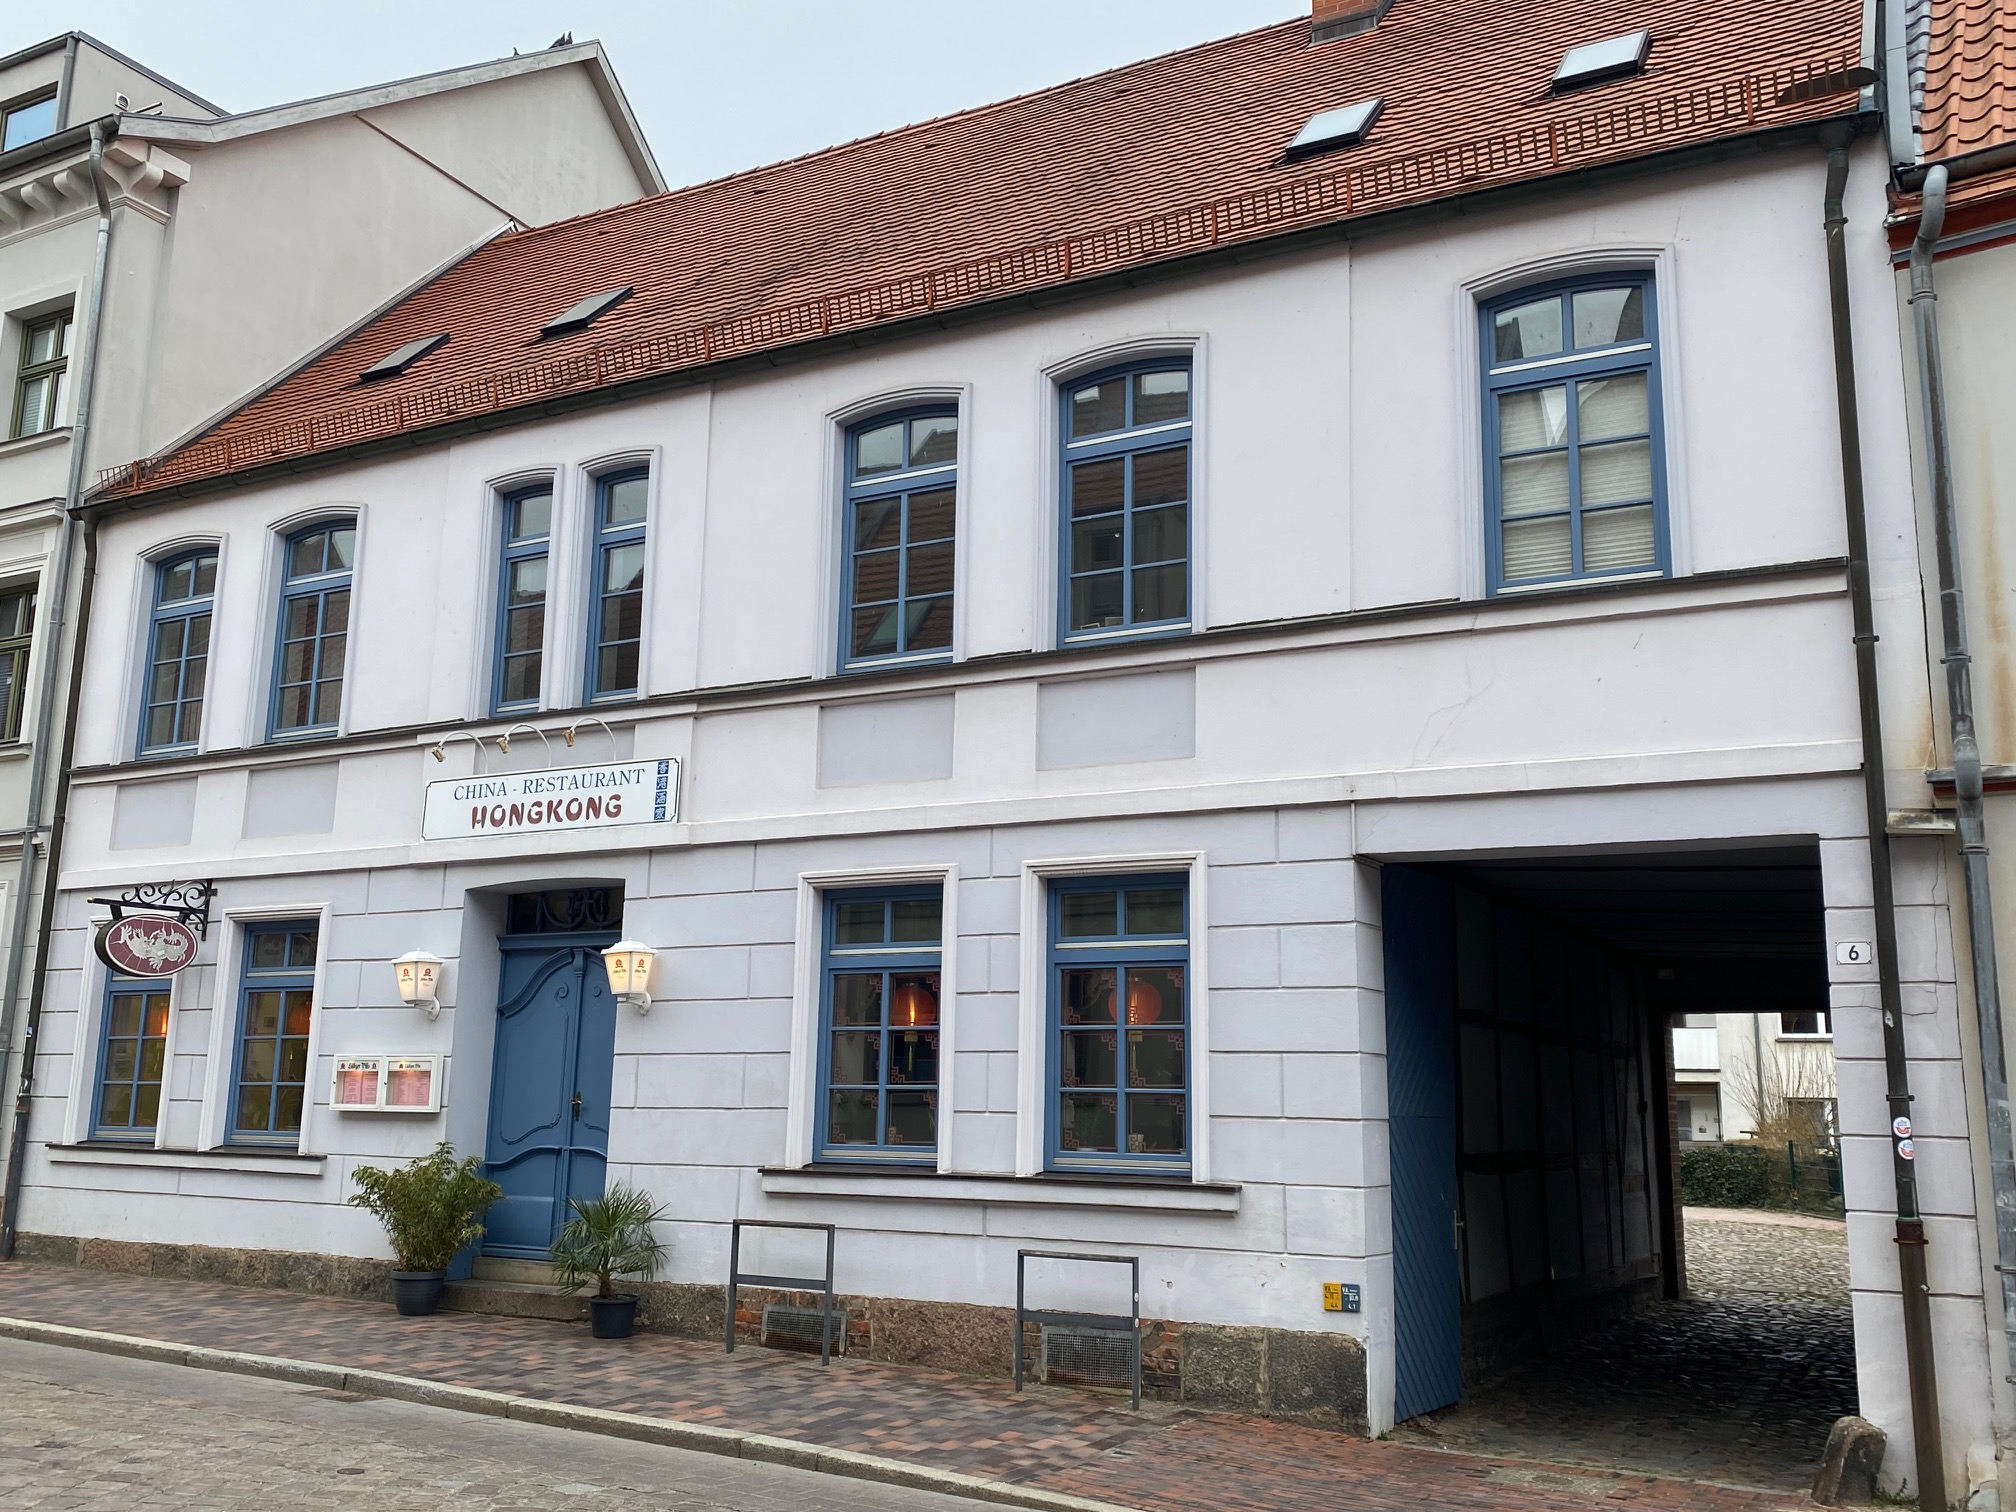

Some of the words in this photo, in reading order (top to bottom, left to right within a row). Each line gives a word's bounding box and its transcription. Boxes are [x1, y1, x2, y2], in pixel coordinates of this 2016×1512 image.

[453, 781, 508, 801] CHINA
[522, 768, 646, 795] RESTAURANT
[471, 793, 623, 830] HONGKONG
[1848, 944, 1860, 961] 6
